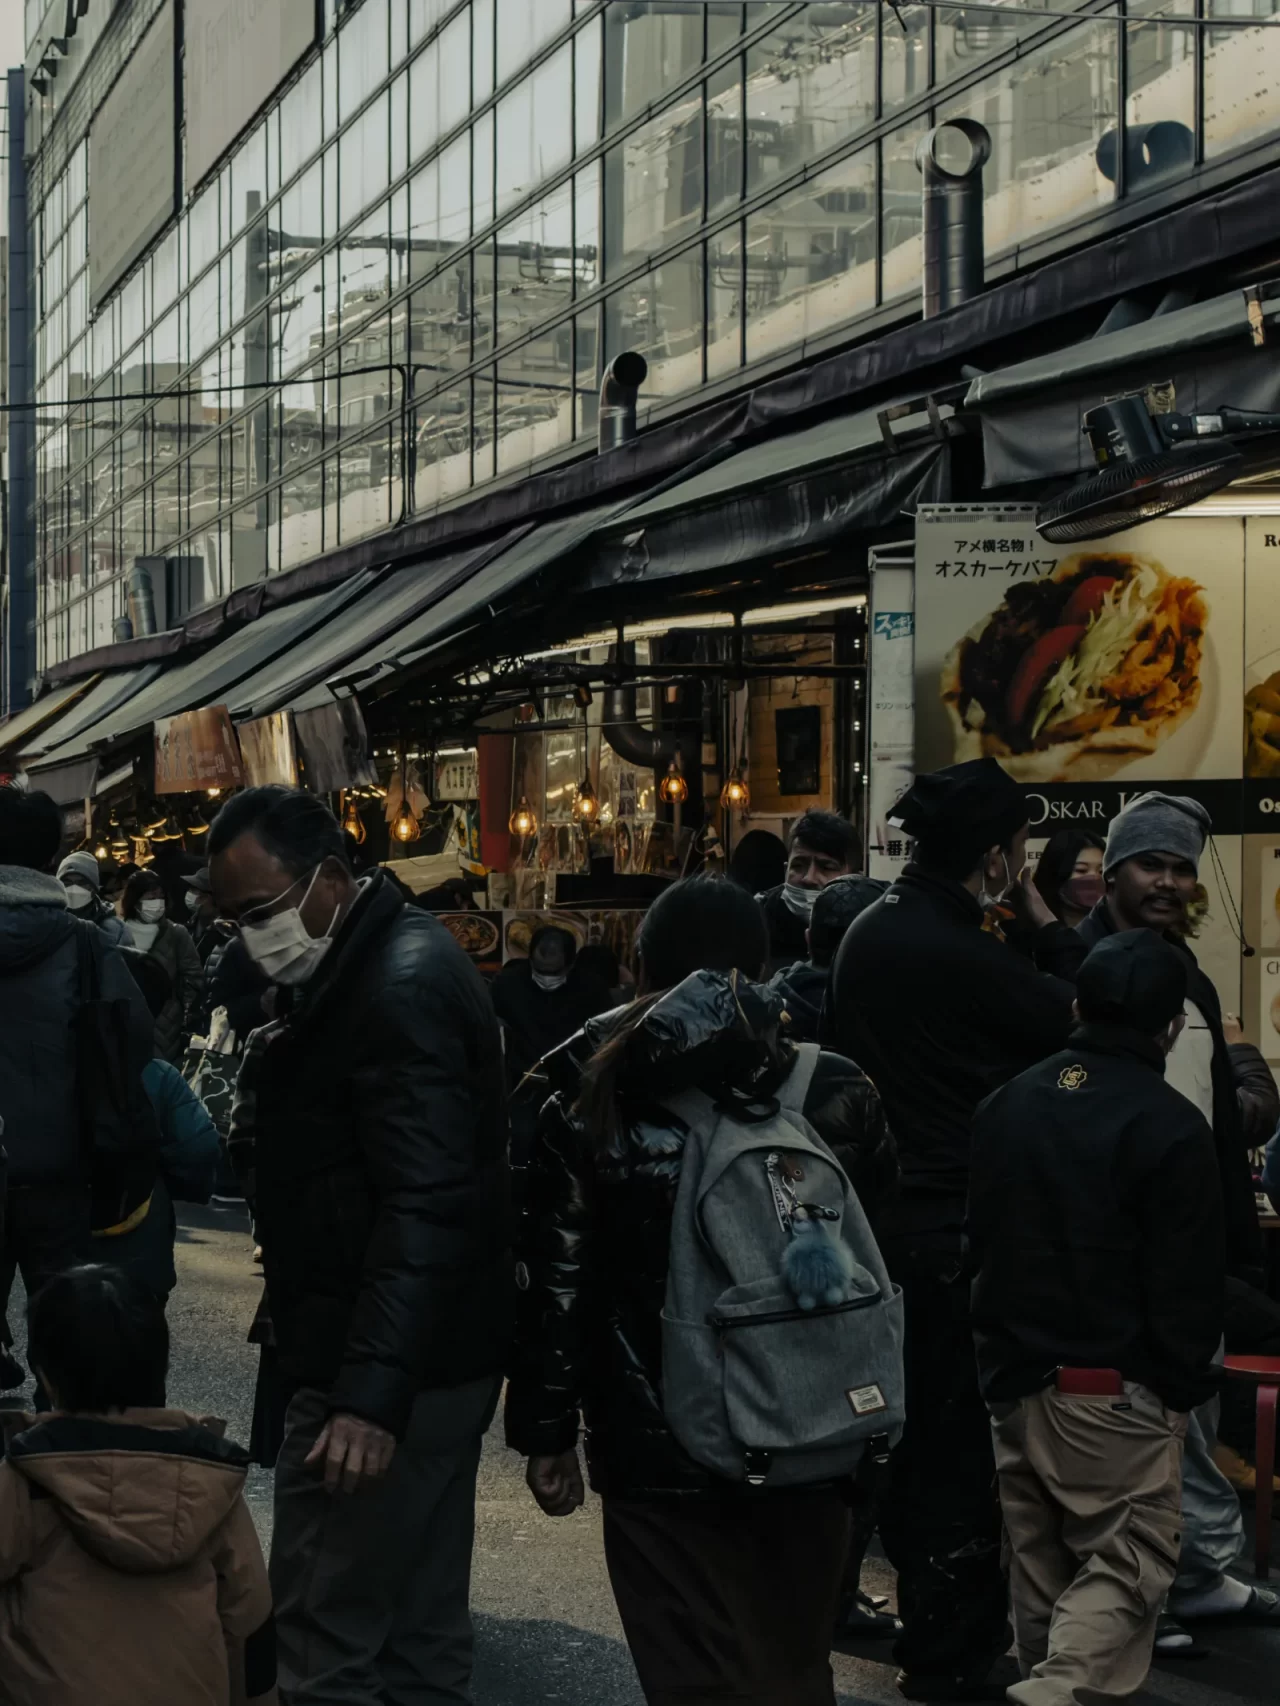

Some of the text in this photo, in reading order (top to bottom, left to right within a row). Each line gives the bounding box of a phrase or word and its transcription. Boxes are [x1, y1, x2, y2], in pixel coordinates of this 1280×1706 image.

[954, 540, 1034, 553] アメ横名物！
[1025, 793, 1106, 825] OSKAR
